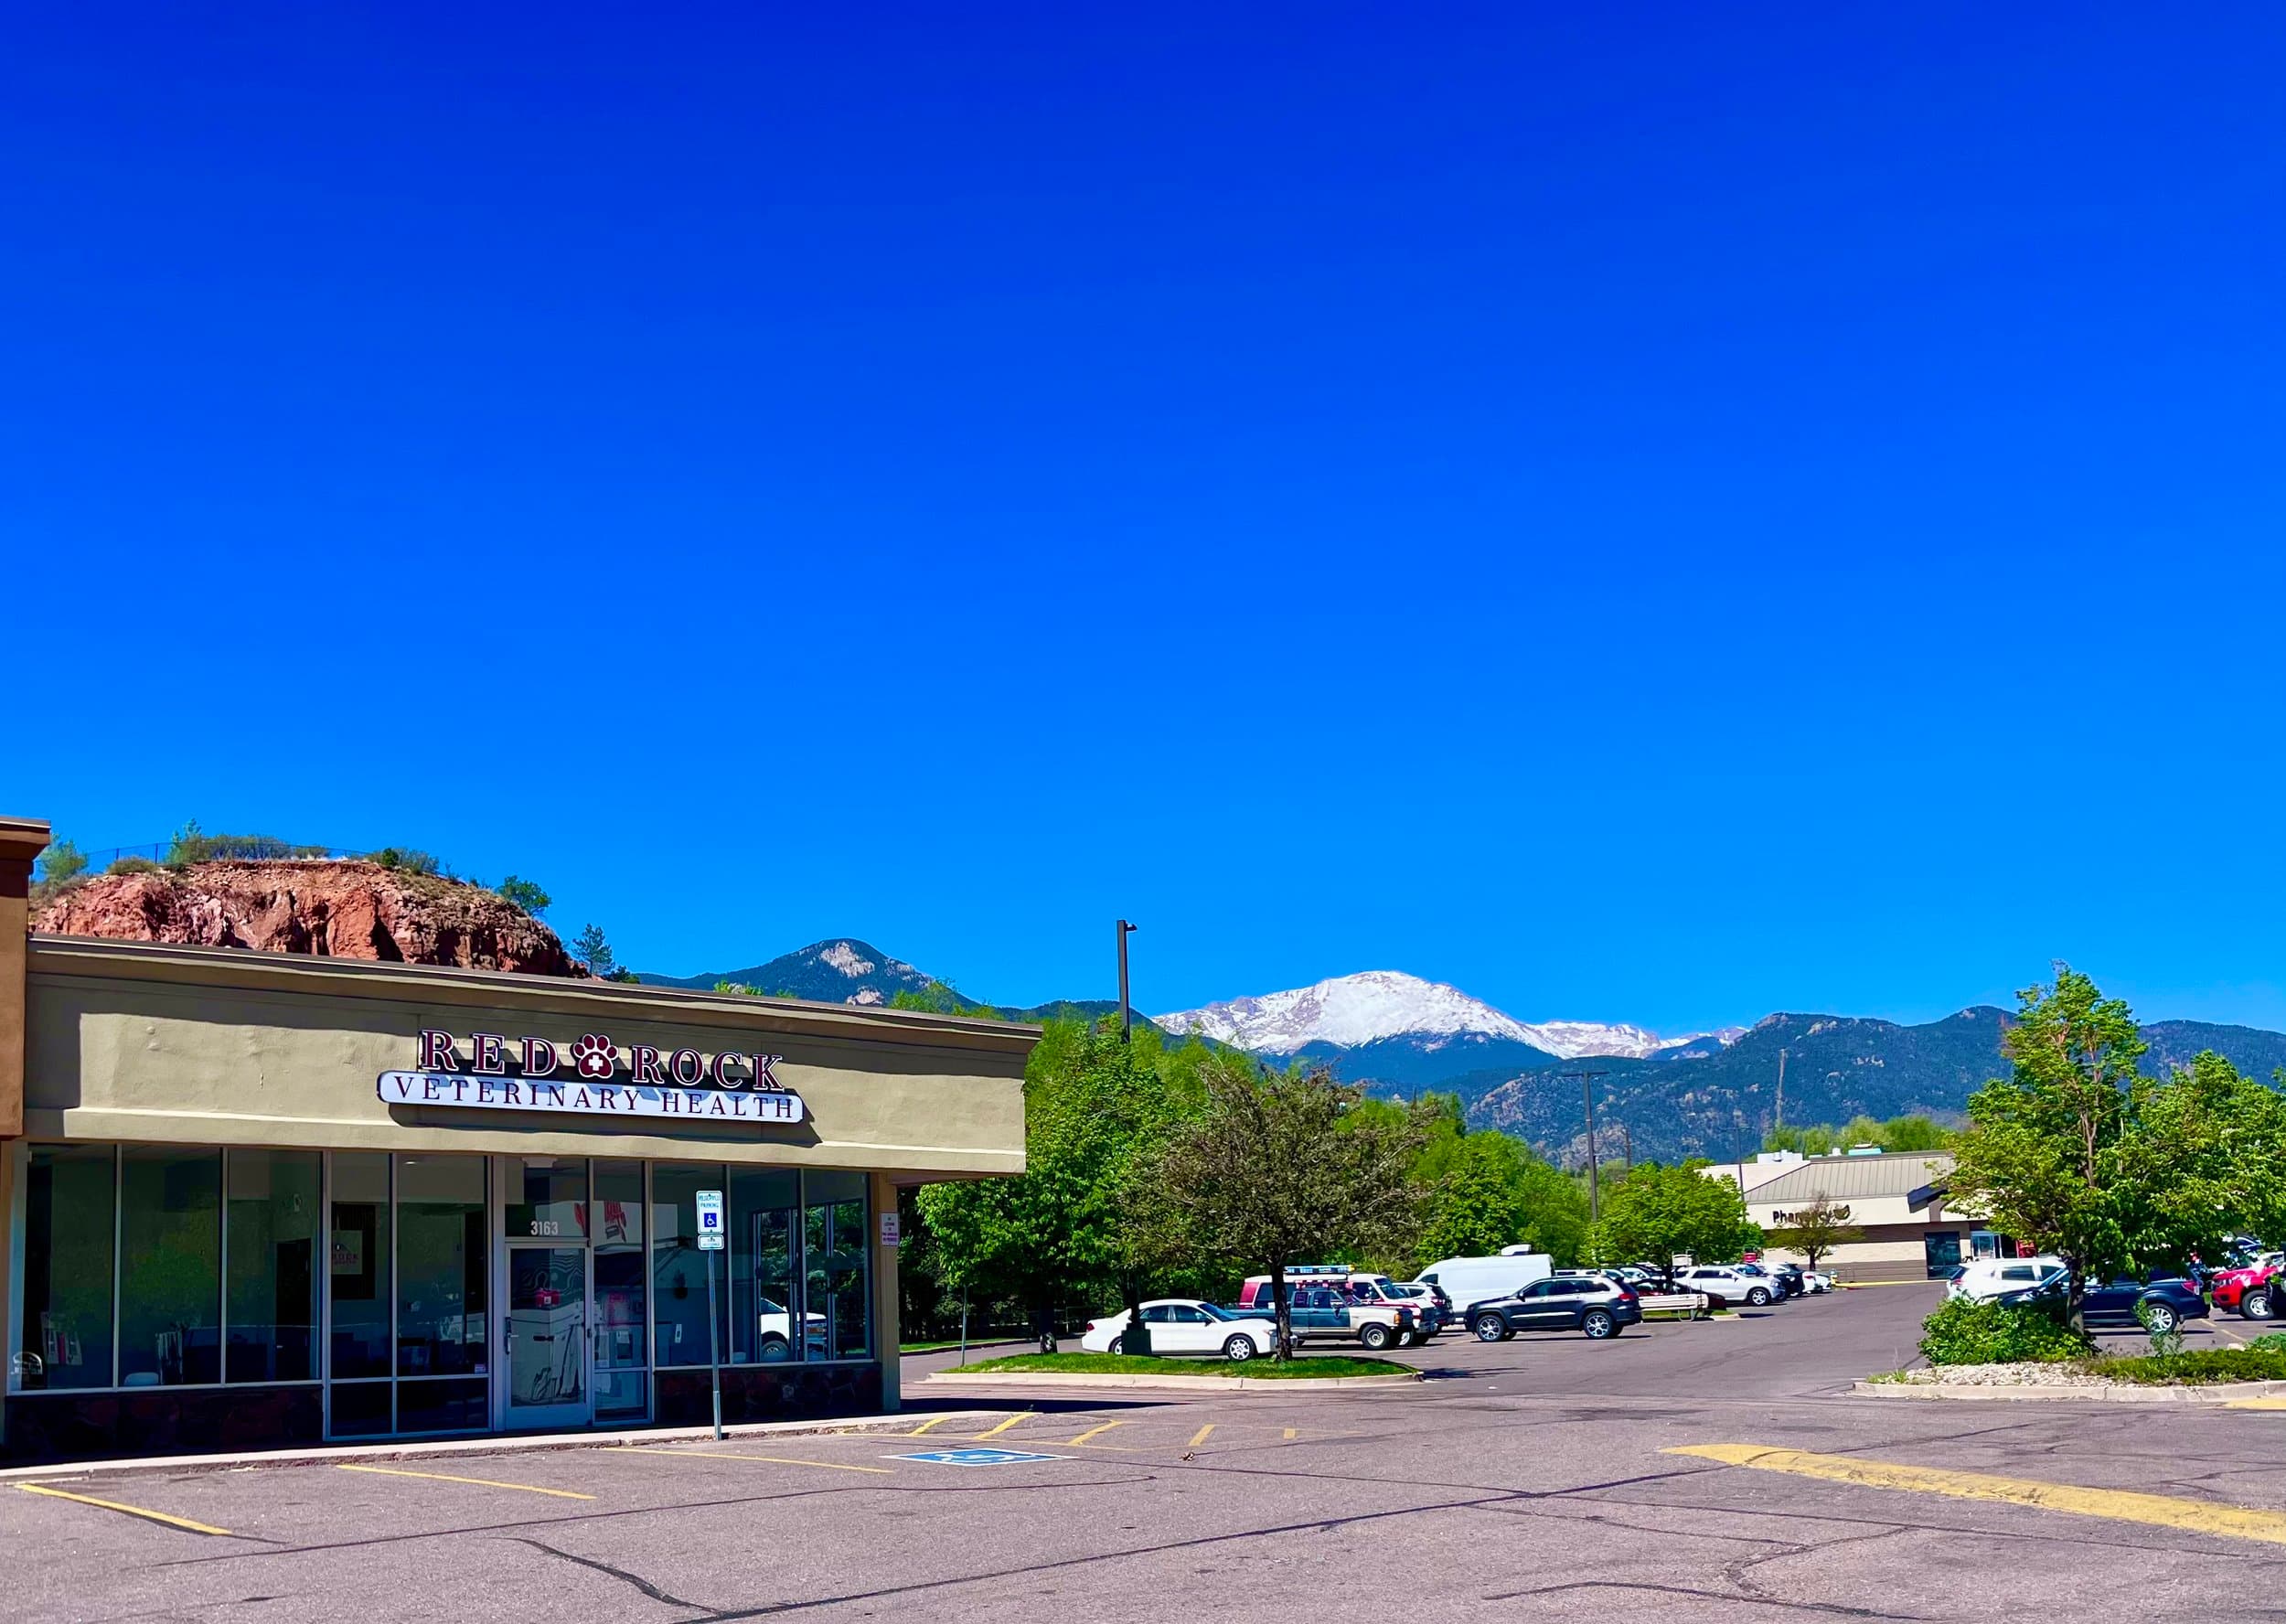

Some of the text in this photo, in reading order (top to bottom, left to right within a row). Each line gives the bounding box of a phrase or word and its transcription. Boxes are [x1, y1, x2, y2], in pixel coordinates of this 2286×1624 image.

[421, 1030, 785, 1092] RED ROCK
[394, 1075, 793, 1118] VETERINARY HEALTH
[529, 1220, 559, 1236] 3163
[1772, 1210, 1832, 1225] Pharcy
